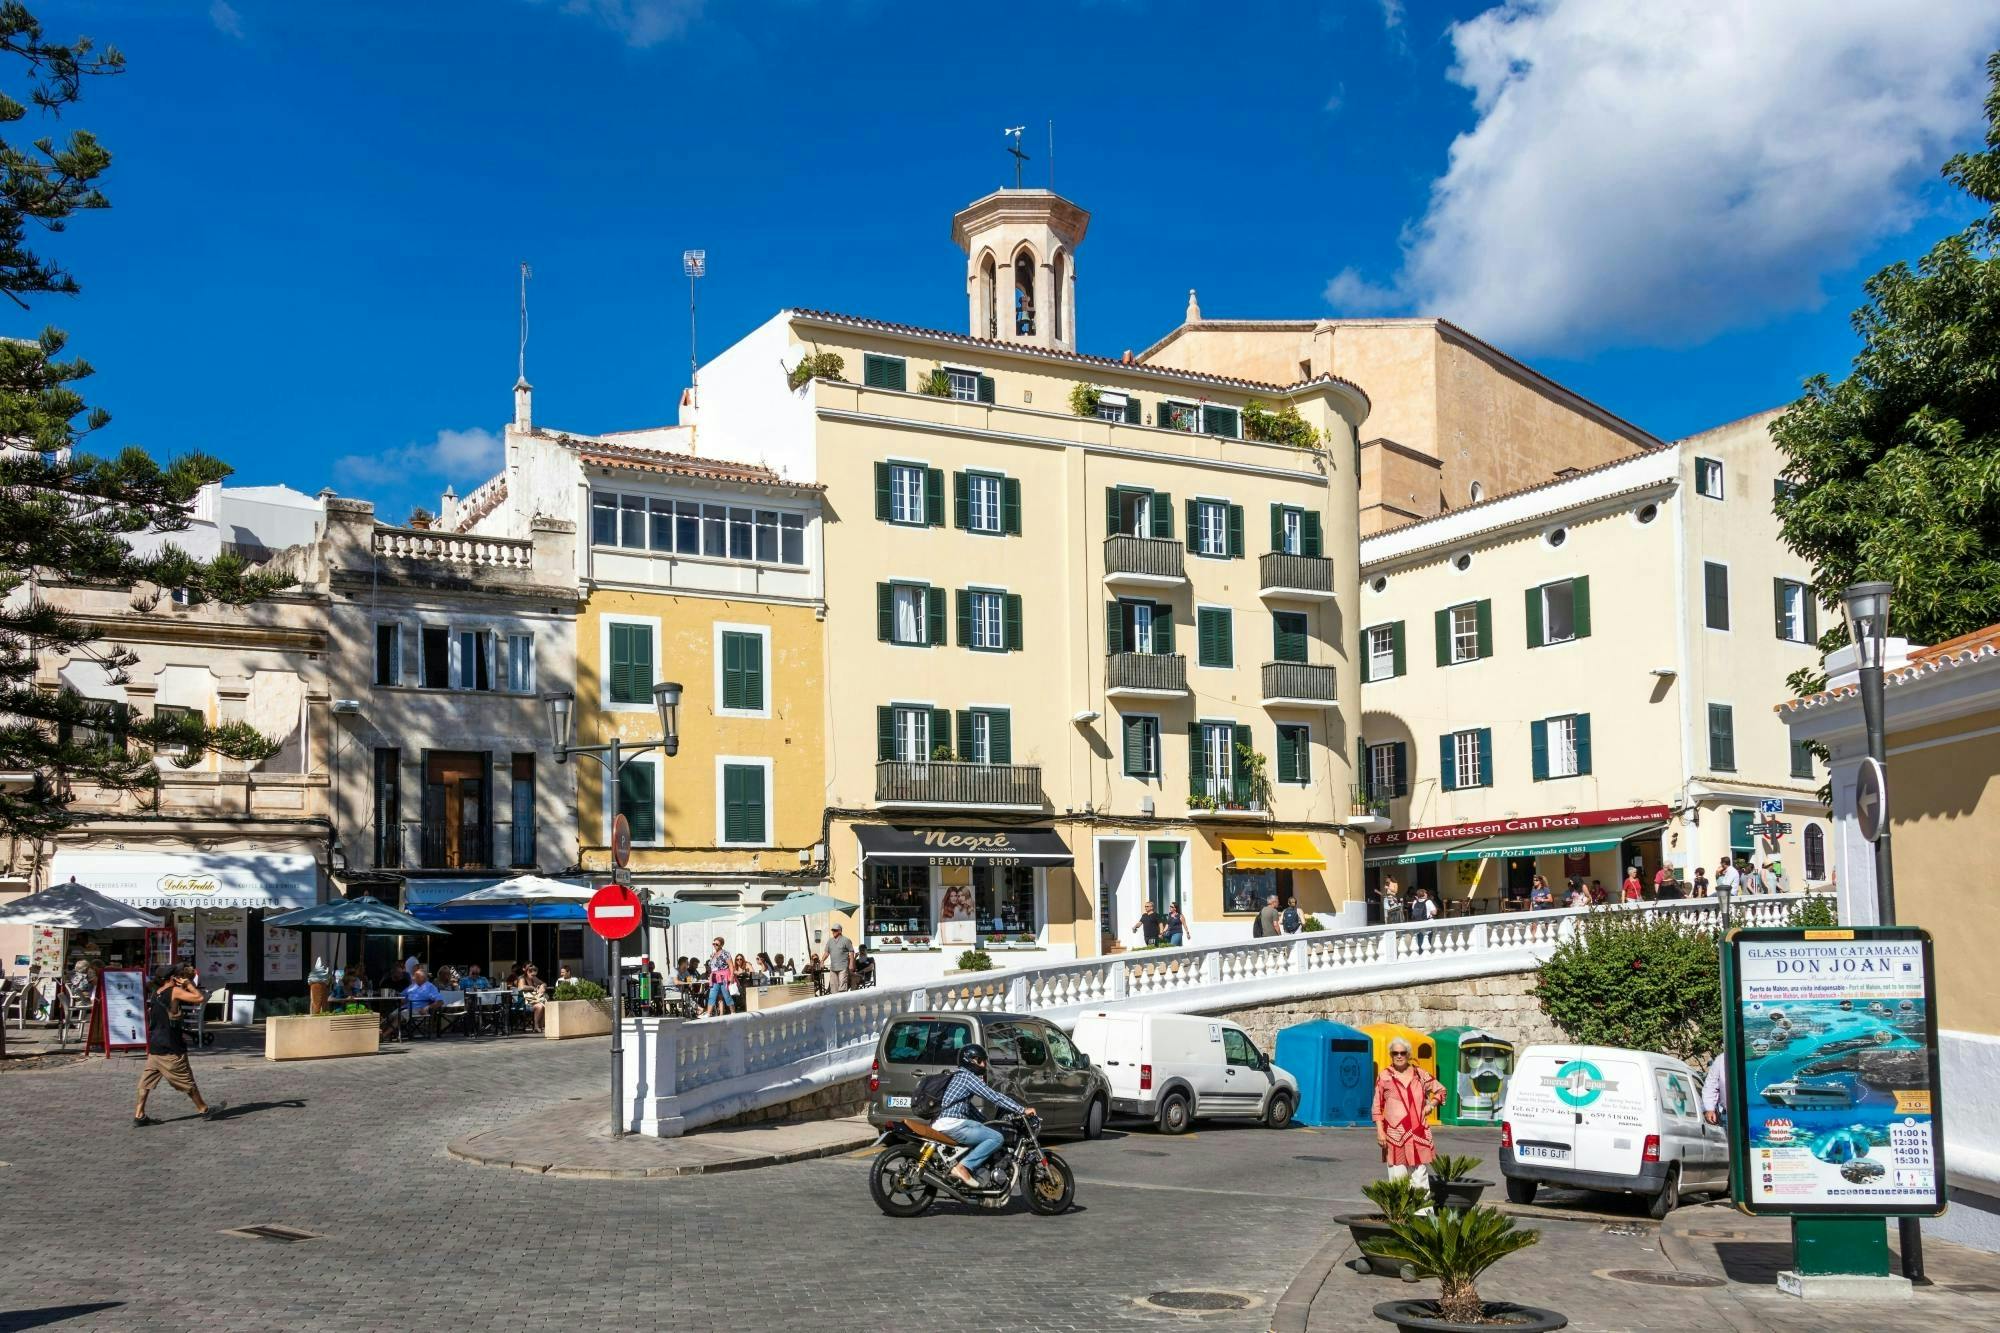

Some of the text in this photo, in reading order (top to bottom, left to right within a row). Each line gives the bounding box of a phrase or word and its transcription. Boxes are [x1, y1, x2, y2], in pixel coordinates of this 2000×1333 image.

[1406, 824, 1501, 841] Delicatessen
[1505, 820, 1538, 831] Can
[1541, 817, 1580, 828] Pota
[1477, 851, 1498, 859] Can
[1500, 849, 1525, 857] Pota
[929, 857, 1020, 866] BEAUTY SHOP
[145, 898, 186, 907] FROZEN
[189, 898, 229, 907] YOGURT
[232, 898, 239, 906] &
[242, 898, 280, 907] GELATO
[1748, 946, 1919, 958] GLASS BOTTOM CATAMARAN
[1776, 958, 1891, 974] DON JOAN
[892, 1097, 908, 1106] 7562
[1764, 1119, 1792, 1127] MAXI
[1893, 1129, 1919, 1137] 11:00
[1894, 1138, 1919, 1146] 12:30
[1525, 1146, 1566, 1159] 6116 GJT
